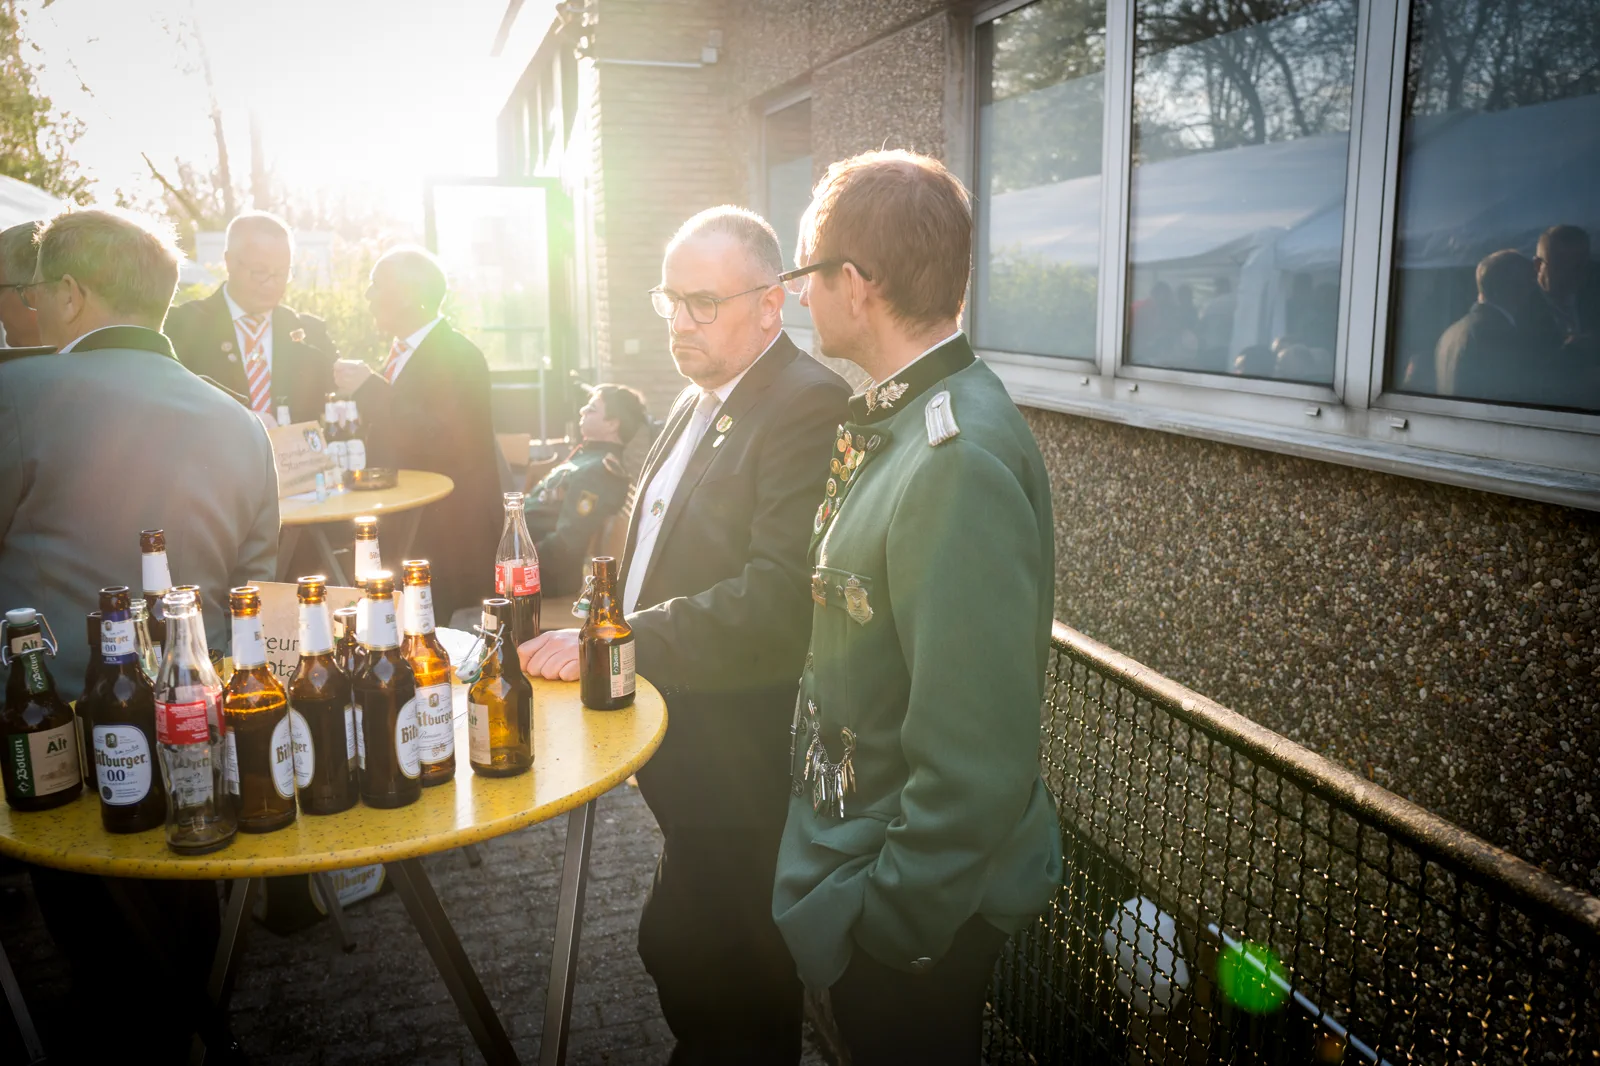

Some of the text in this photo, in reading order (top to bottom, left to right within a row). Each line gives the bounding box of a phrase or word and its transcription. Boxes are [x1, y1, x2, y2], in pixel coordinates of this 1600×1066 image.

[22, 640, 38, 651] Alt
[47, 738, 67, 754] Alt
[15, 739, 28, 780] Bolten
